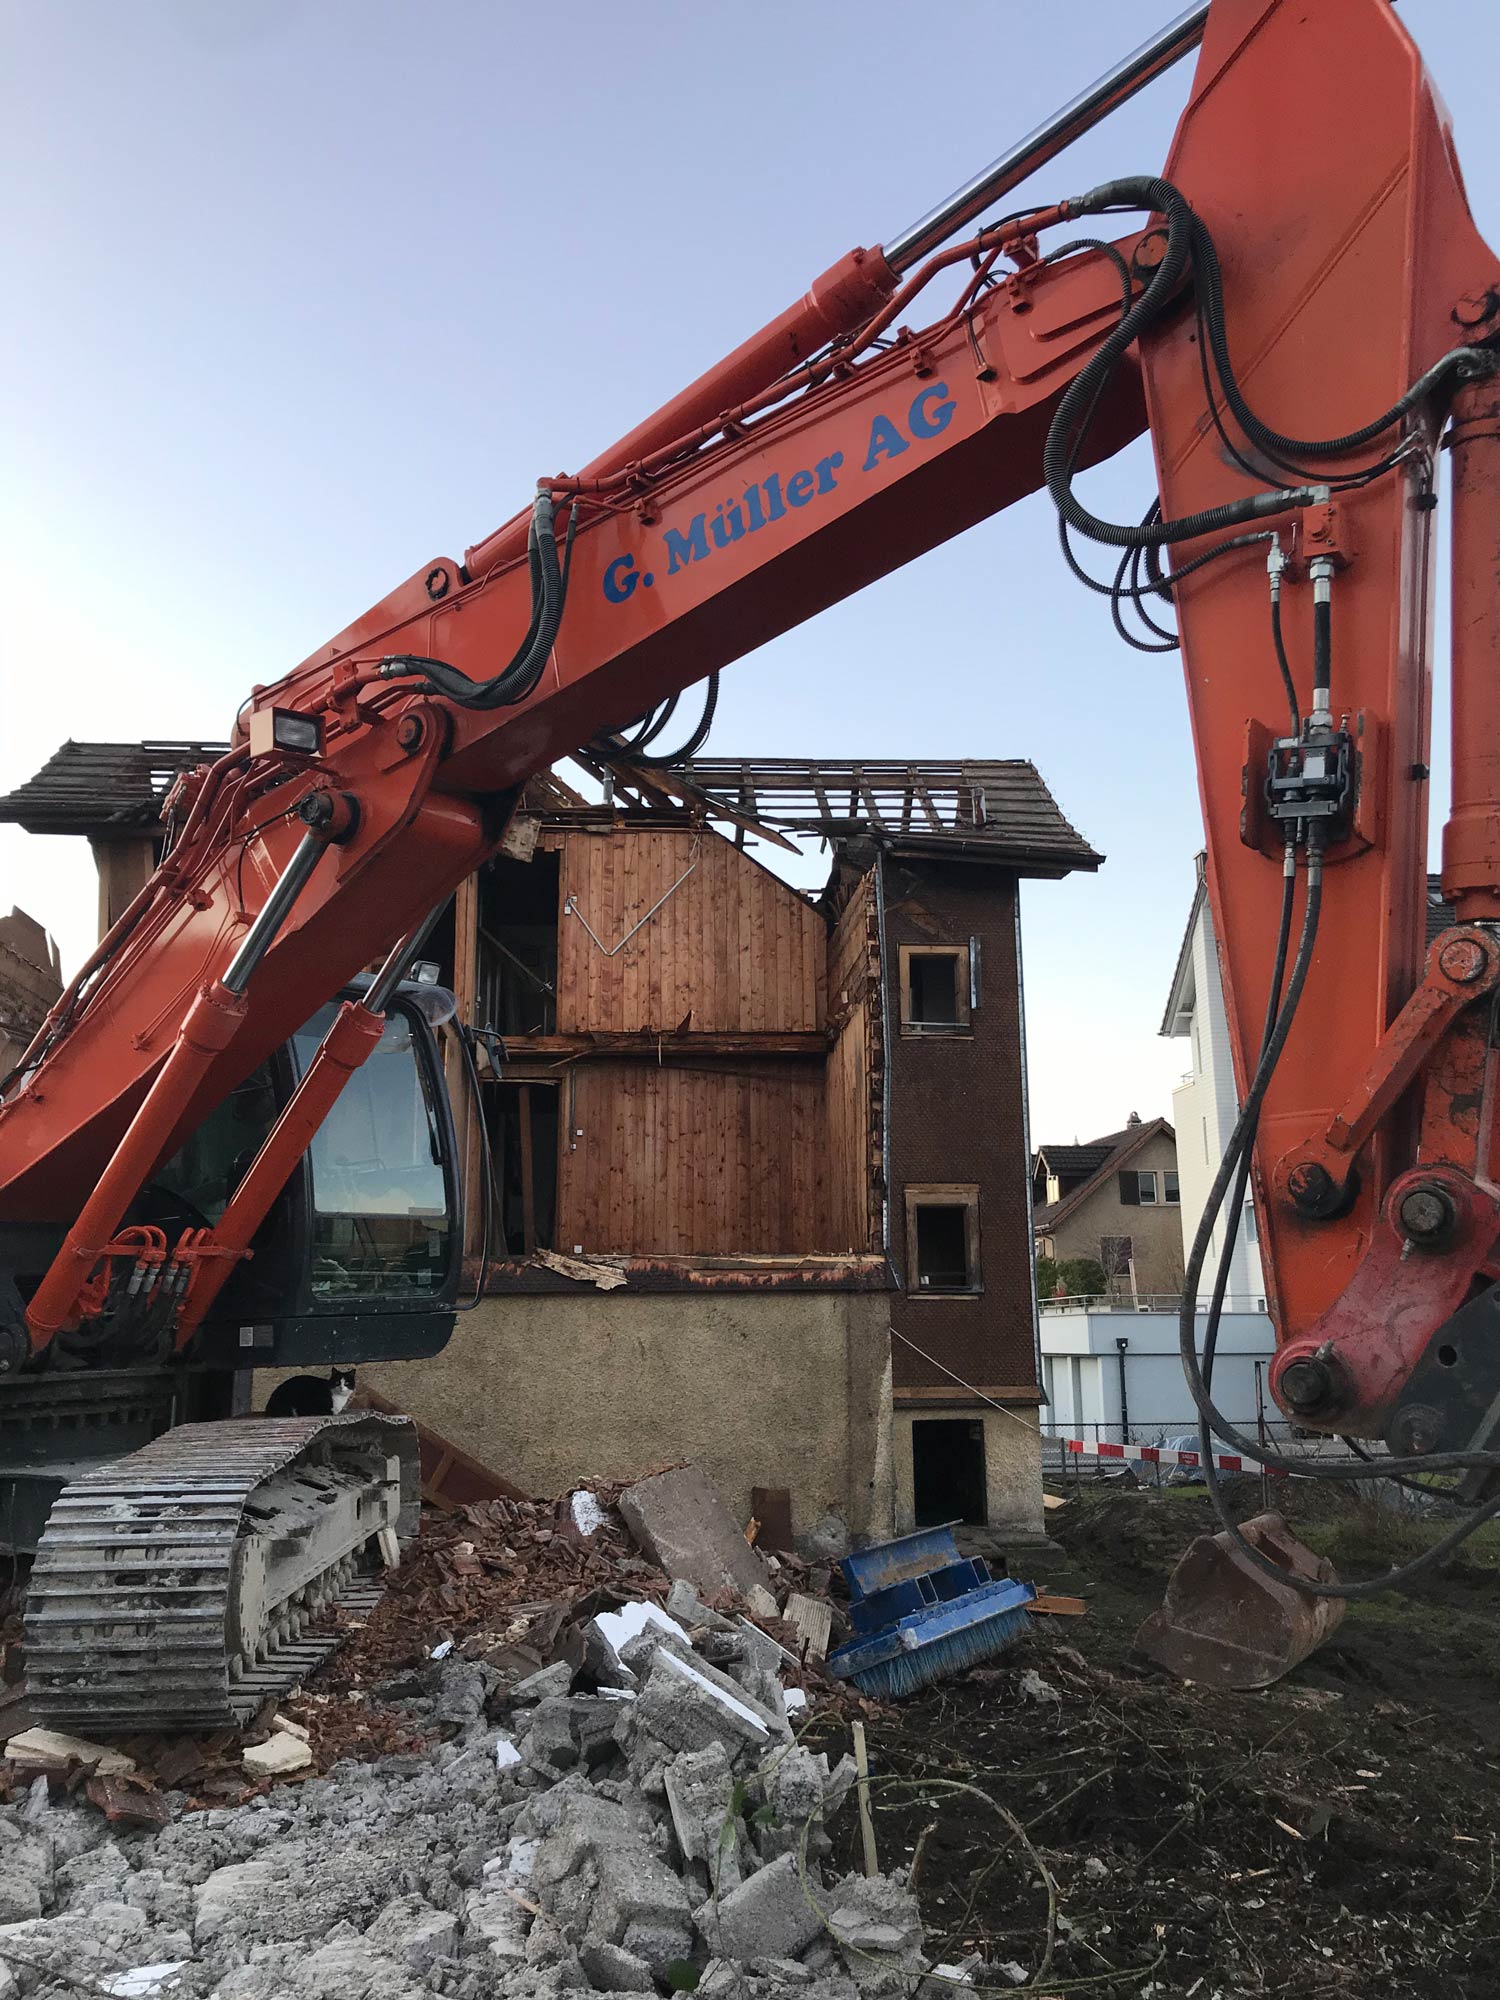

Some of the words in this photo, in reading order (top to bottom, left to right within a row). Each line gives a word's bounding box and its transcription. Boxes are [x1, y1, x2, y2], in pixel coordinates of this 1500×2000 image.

[603, 553, 655, 604] G.
[663, 451, 844, 576] Müller
[862, 382, 957, 472] AG
